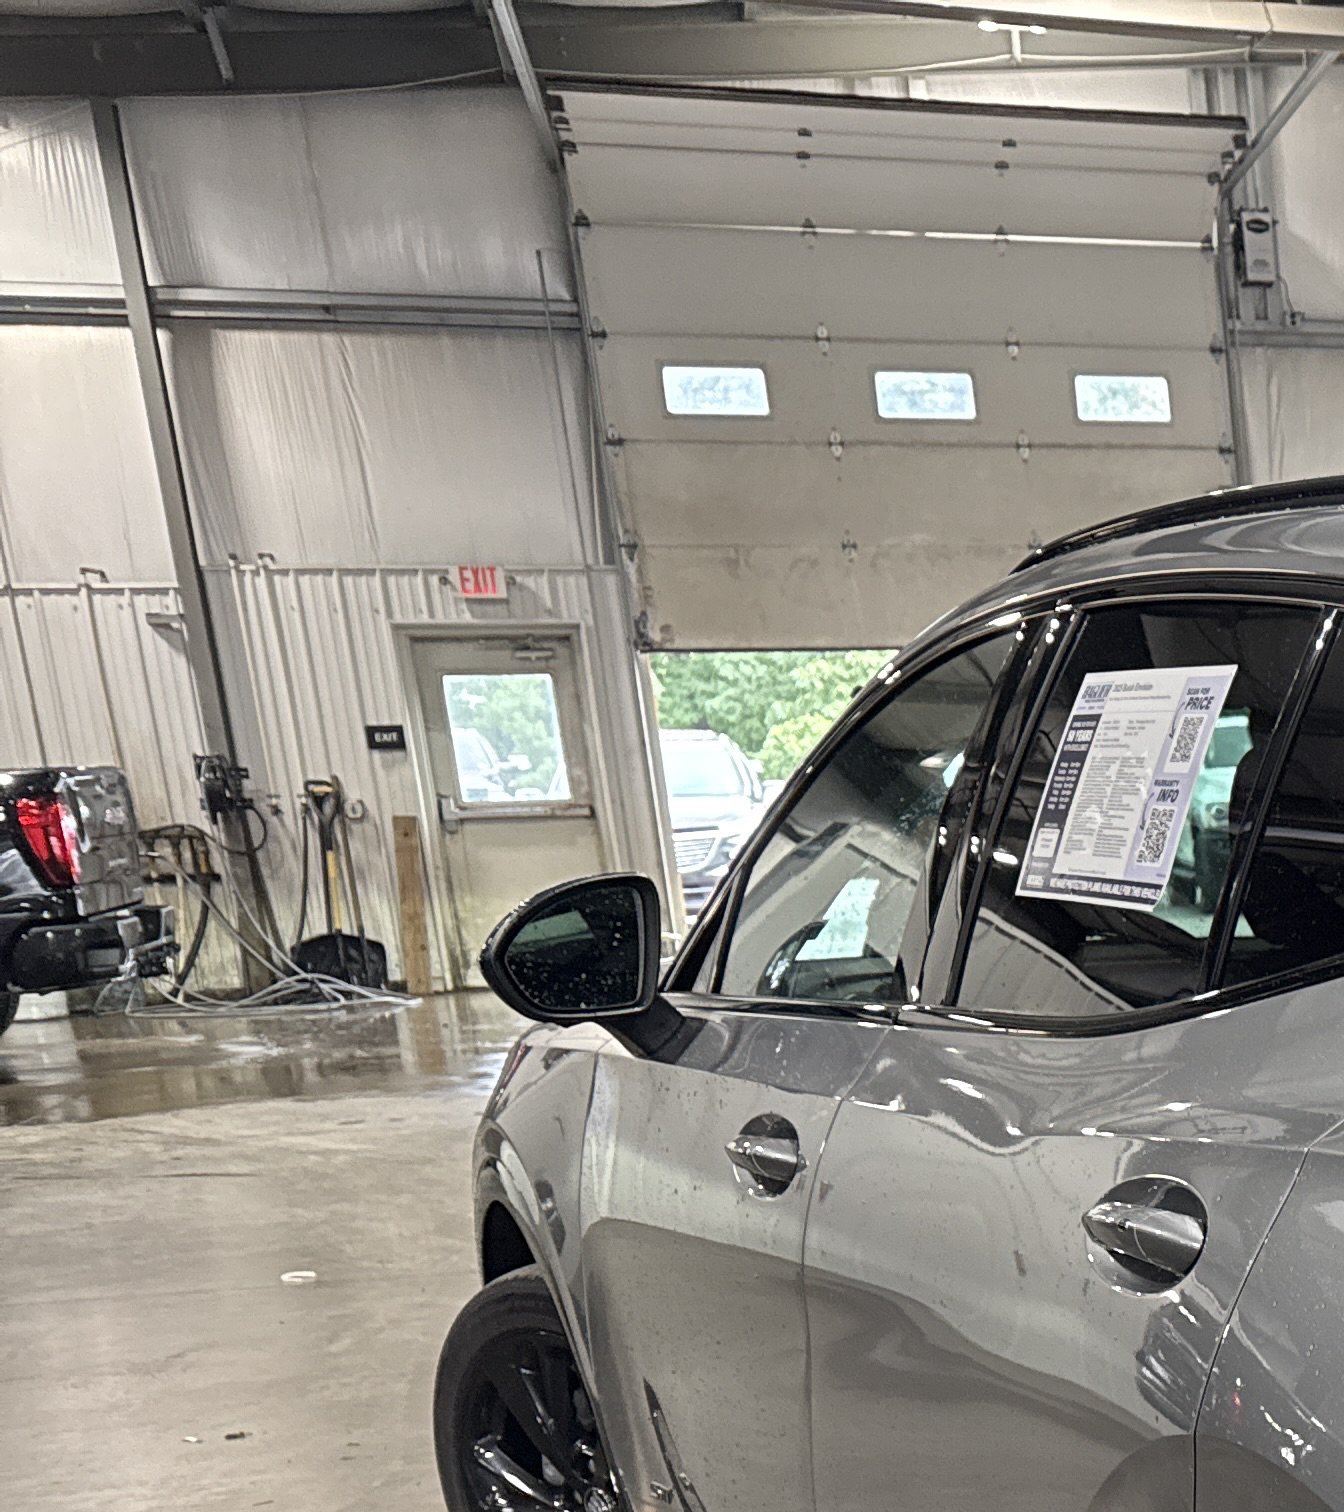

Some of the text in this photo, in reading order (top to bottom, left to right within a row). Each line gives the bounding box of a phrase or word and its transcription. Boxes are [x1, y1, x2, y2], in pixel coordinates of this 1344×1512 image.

[458, 565, 498, 598] EXIT
[1184, 697, 1215, 711] PRICE
[374, 731, 399, 743] EXIT
[1156, 788, 1180, 803] INFO
